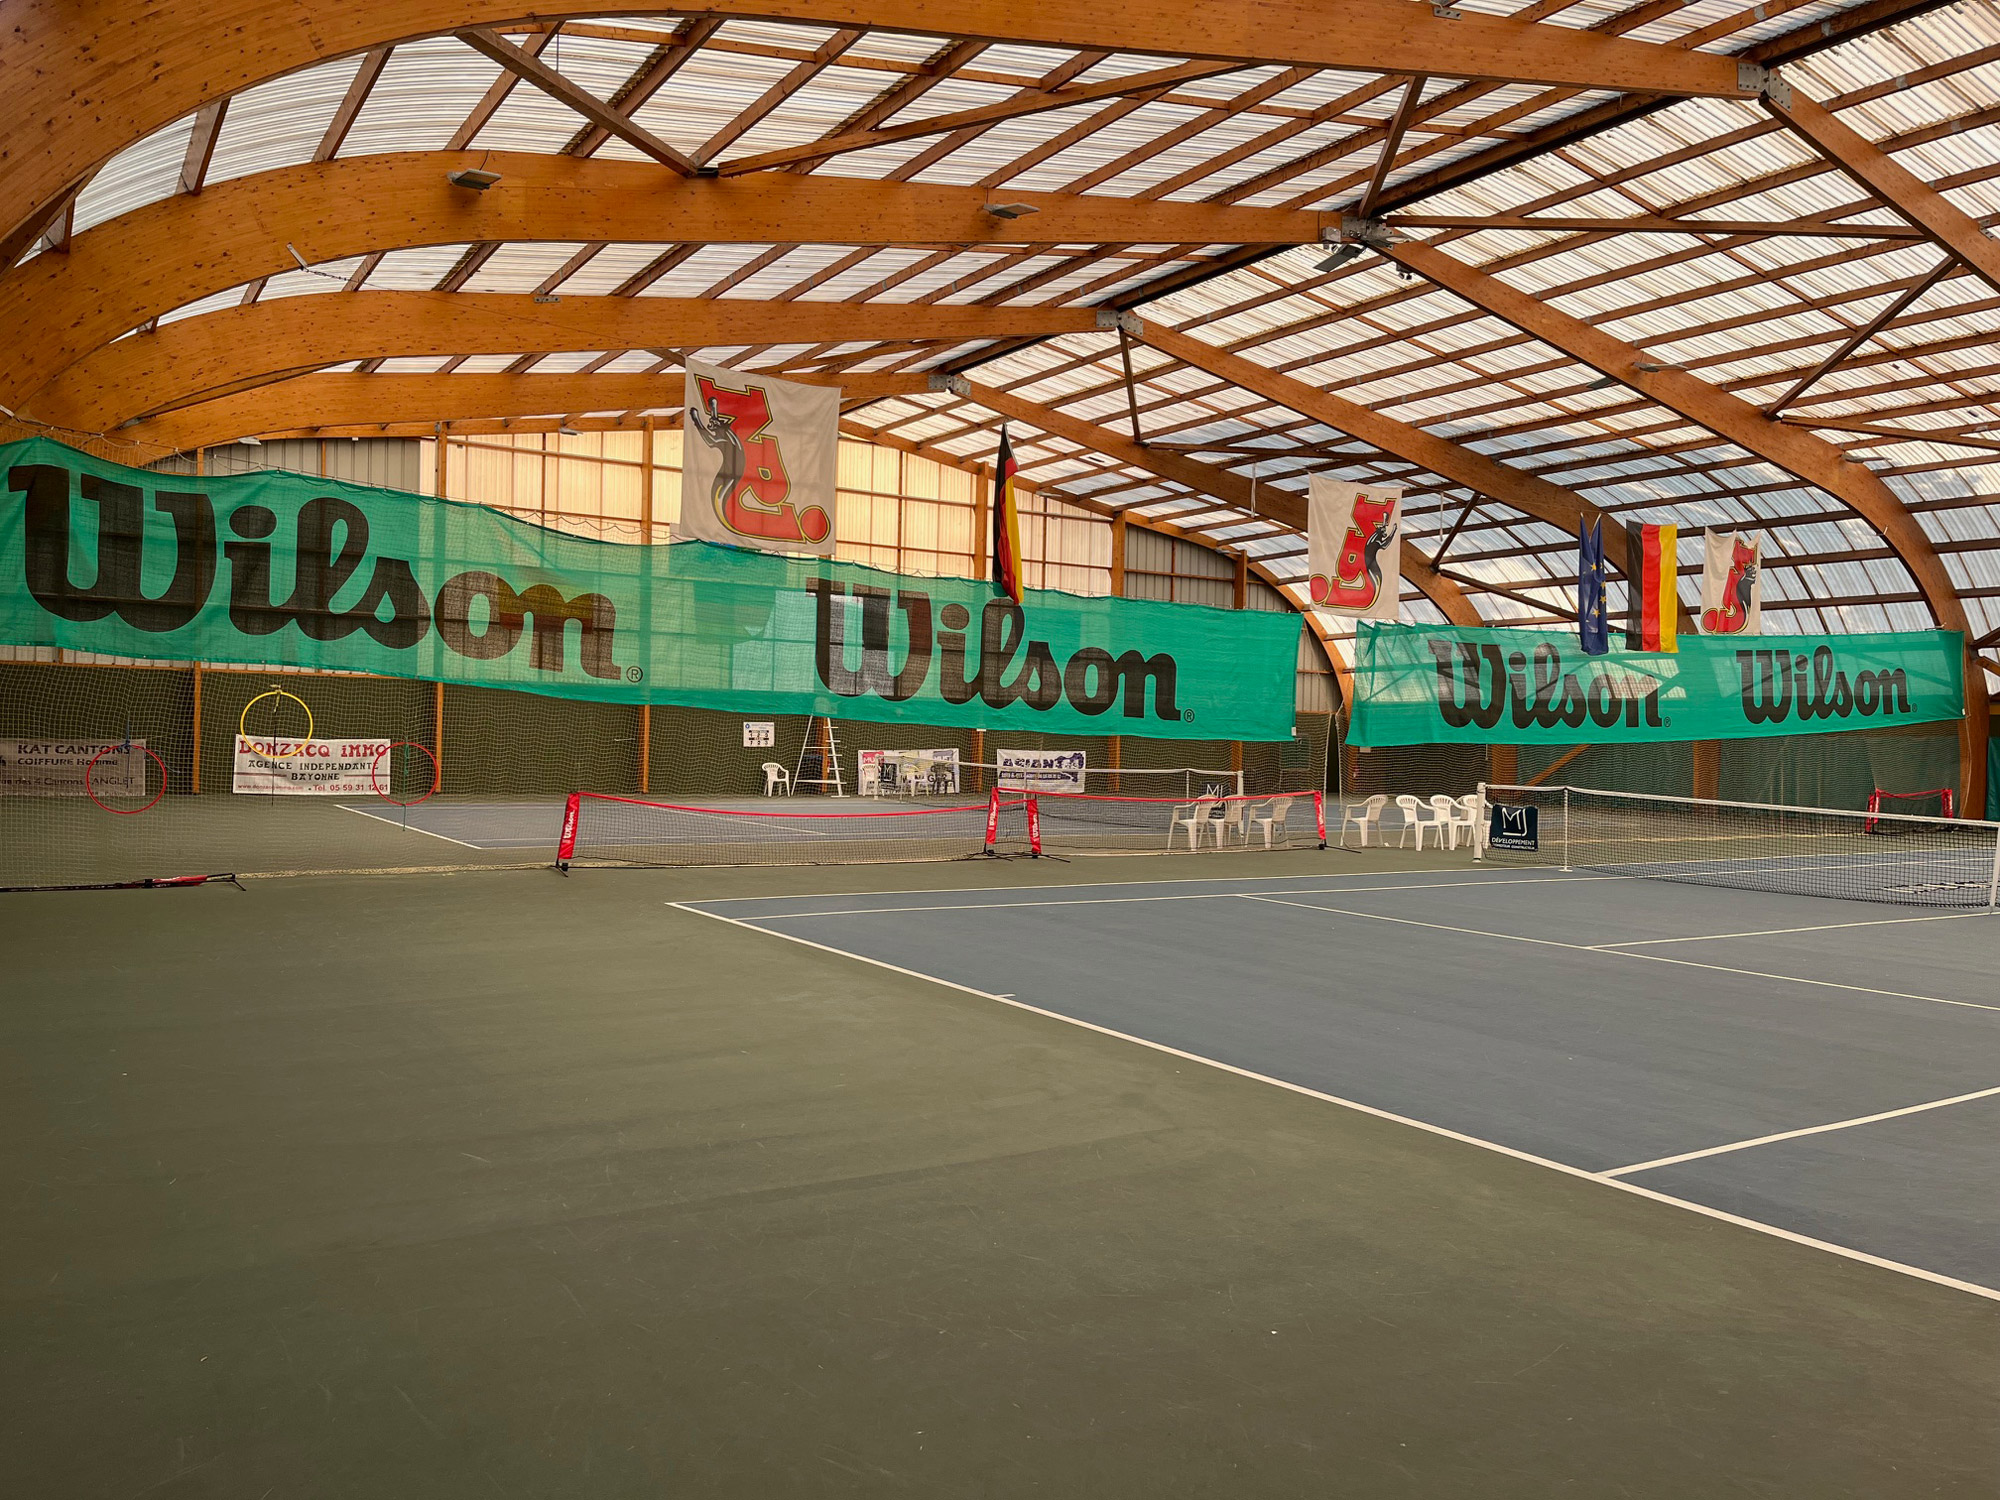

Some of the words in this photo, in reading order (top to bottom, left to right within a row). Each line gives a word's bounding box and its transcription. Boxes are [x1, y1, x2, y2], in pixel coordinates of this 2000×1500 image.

[17, 744, 51, 755] KAT
[54, 744, 130, 755] CANTONS
[239, 740, 330, 758] DONZACQ
[17, 758, 74, 766] COIFFURE
[248, 759, 293, 770] AGENCE
[299, 762, 379, 771] INDEPENDANTE
[93, 776, 136, 785] ANGLET
[291, 773, 340, 781] BAYONNE
